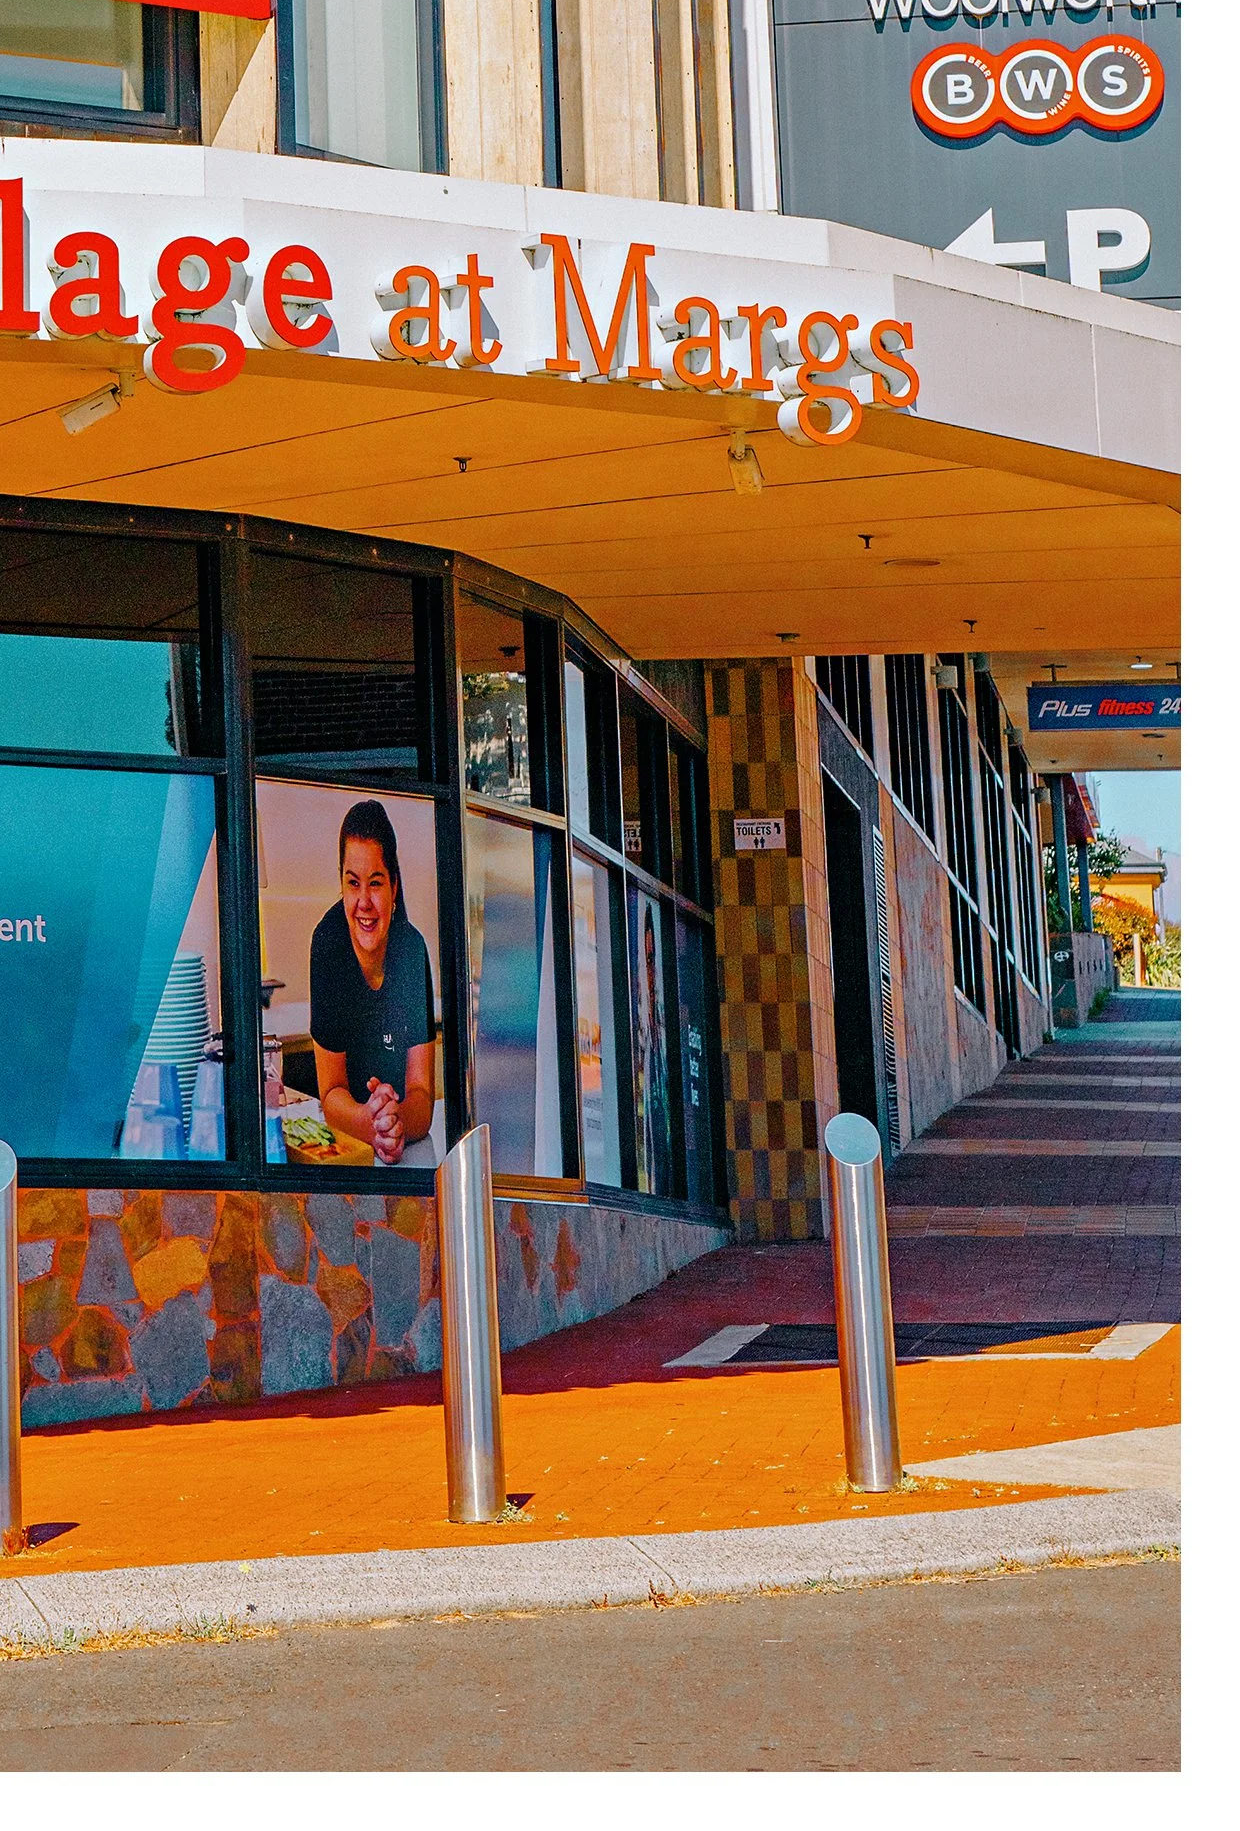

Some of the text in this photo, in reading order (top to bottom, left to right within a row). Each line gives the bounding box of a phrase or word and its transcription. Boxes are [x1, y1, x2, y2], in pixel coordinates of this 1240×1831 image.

[967, 55, 992, 79] BEER
[1116, 45, 1151, 76] SPIRITS
[1047, 92, 1072, 117] WINE
[1066, 208, 1151, 292] P
[382, 253, 503, 366] at
[535, 232, 921, 446] Margs
[1038, 697, 1181, 718] Plus fitness 24
[736, 826, 772, 836] TOILETS
